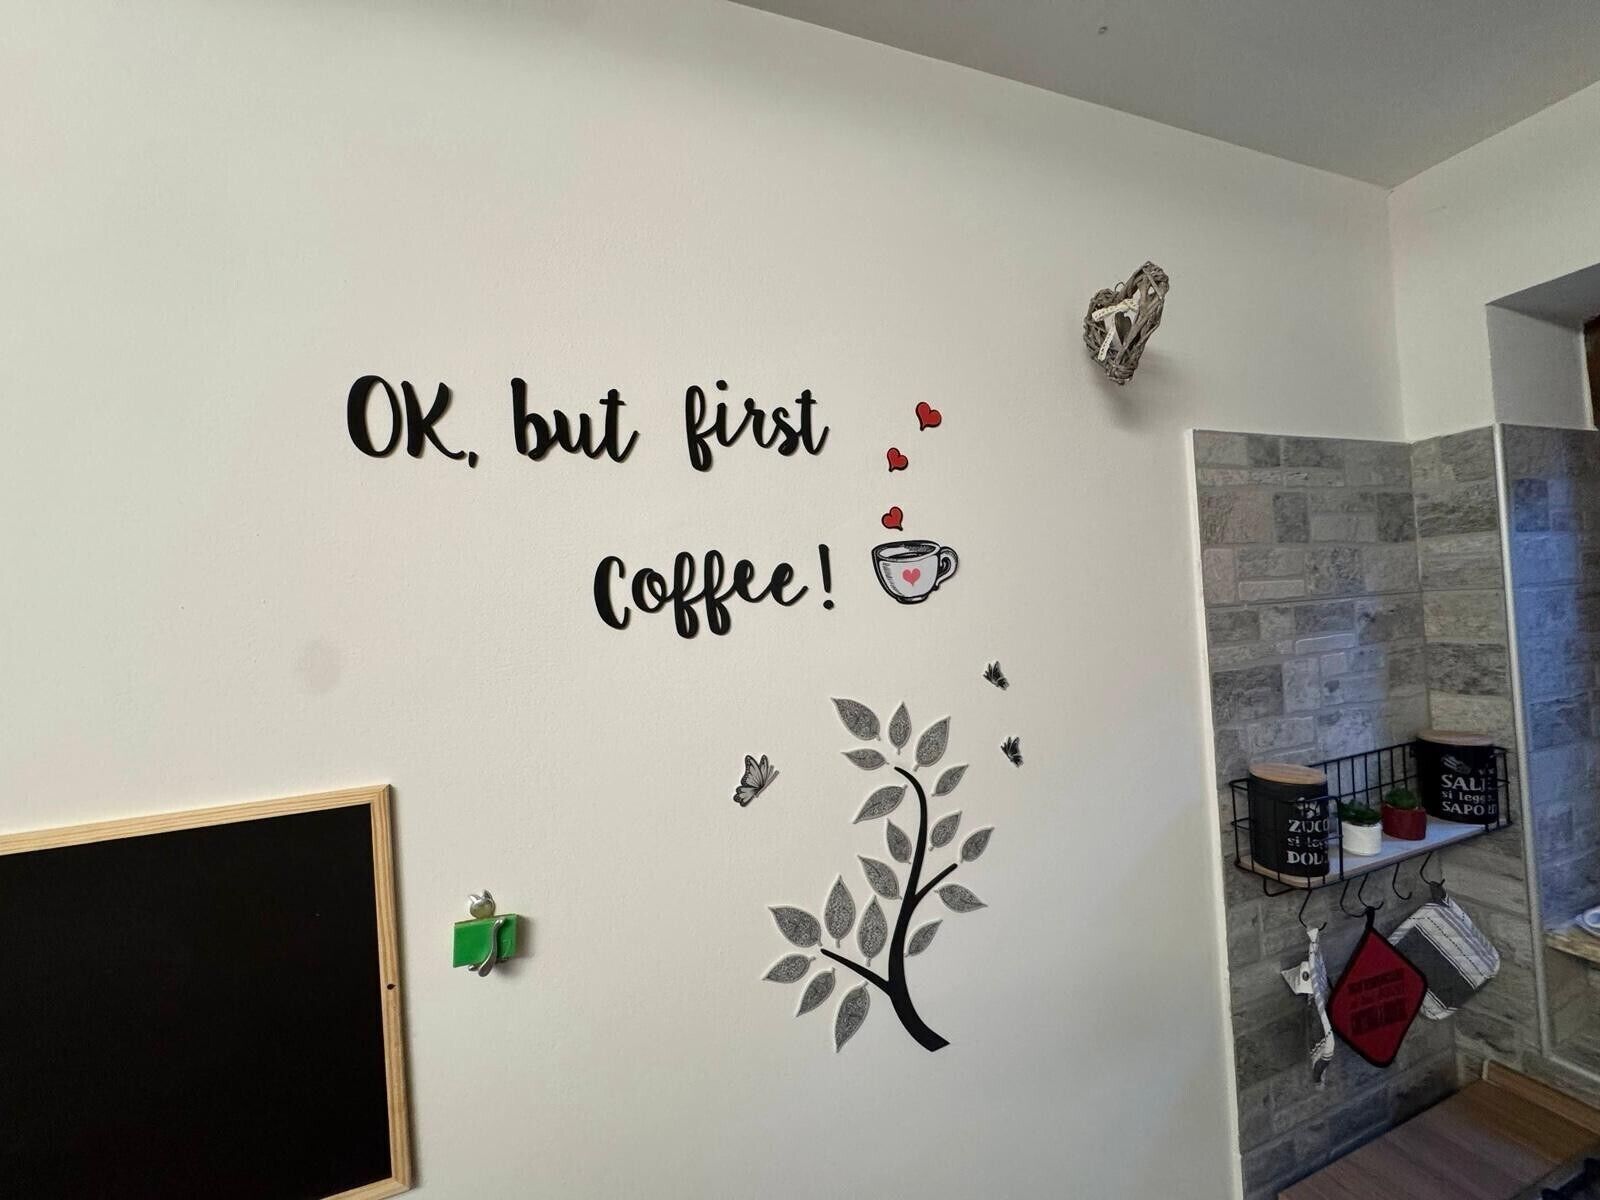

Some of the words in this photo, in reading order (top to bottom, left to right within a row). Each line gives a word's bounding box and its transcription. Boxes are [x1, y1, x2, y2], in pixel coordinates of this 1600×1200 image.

[347, 374, 479, 469] OK,
[511, 377, 639, 463] but
[685, 379, 830, 473] first
